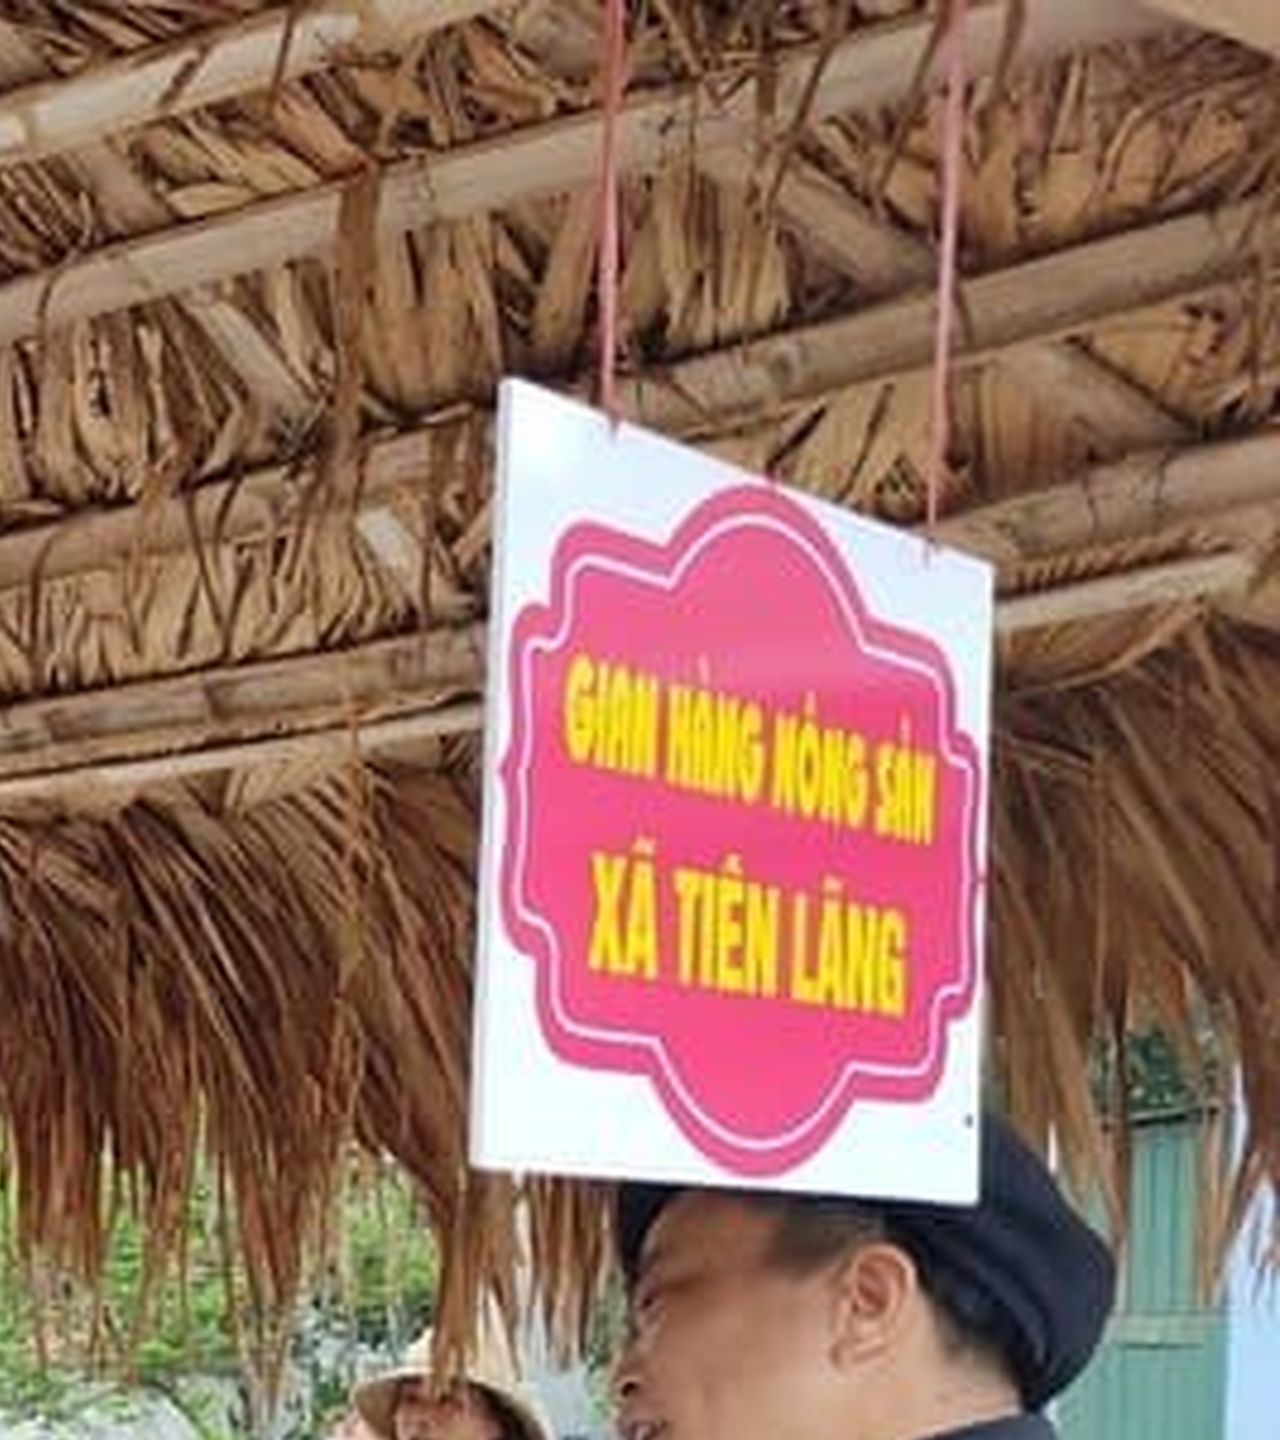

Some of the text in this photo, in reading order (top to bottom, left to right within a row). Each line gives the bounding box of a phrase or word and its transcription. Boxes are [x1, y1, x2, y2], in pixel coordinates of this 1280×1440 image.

[566, 655, 658, 778] GIAN
[664, 656, 765, 804] HÀNG
[771, 690, 868, 828] NÔNG
[589, 835, 657, 981] XÃ
[673, 853, 780, 998] TIÊN
